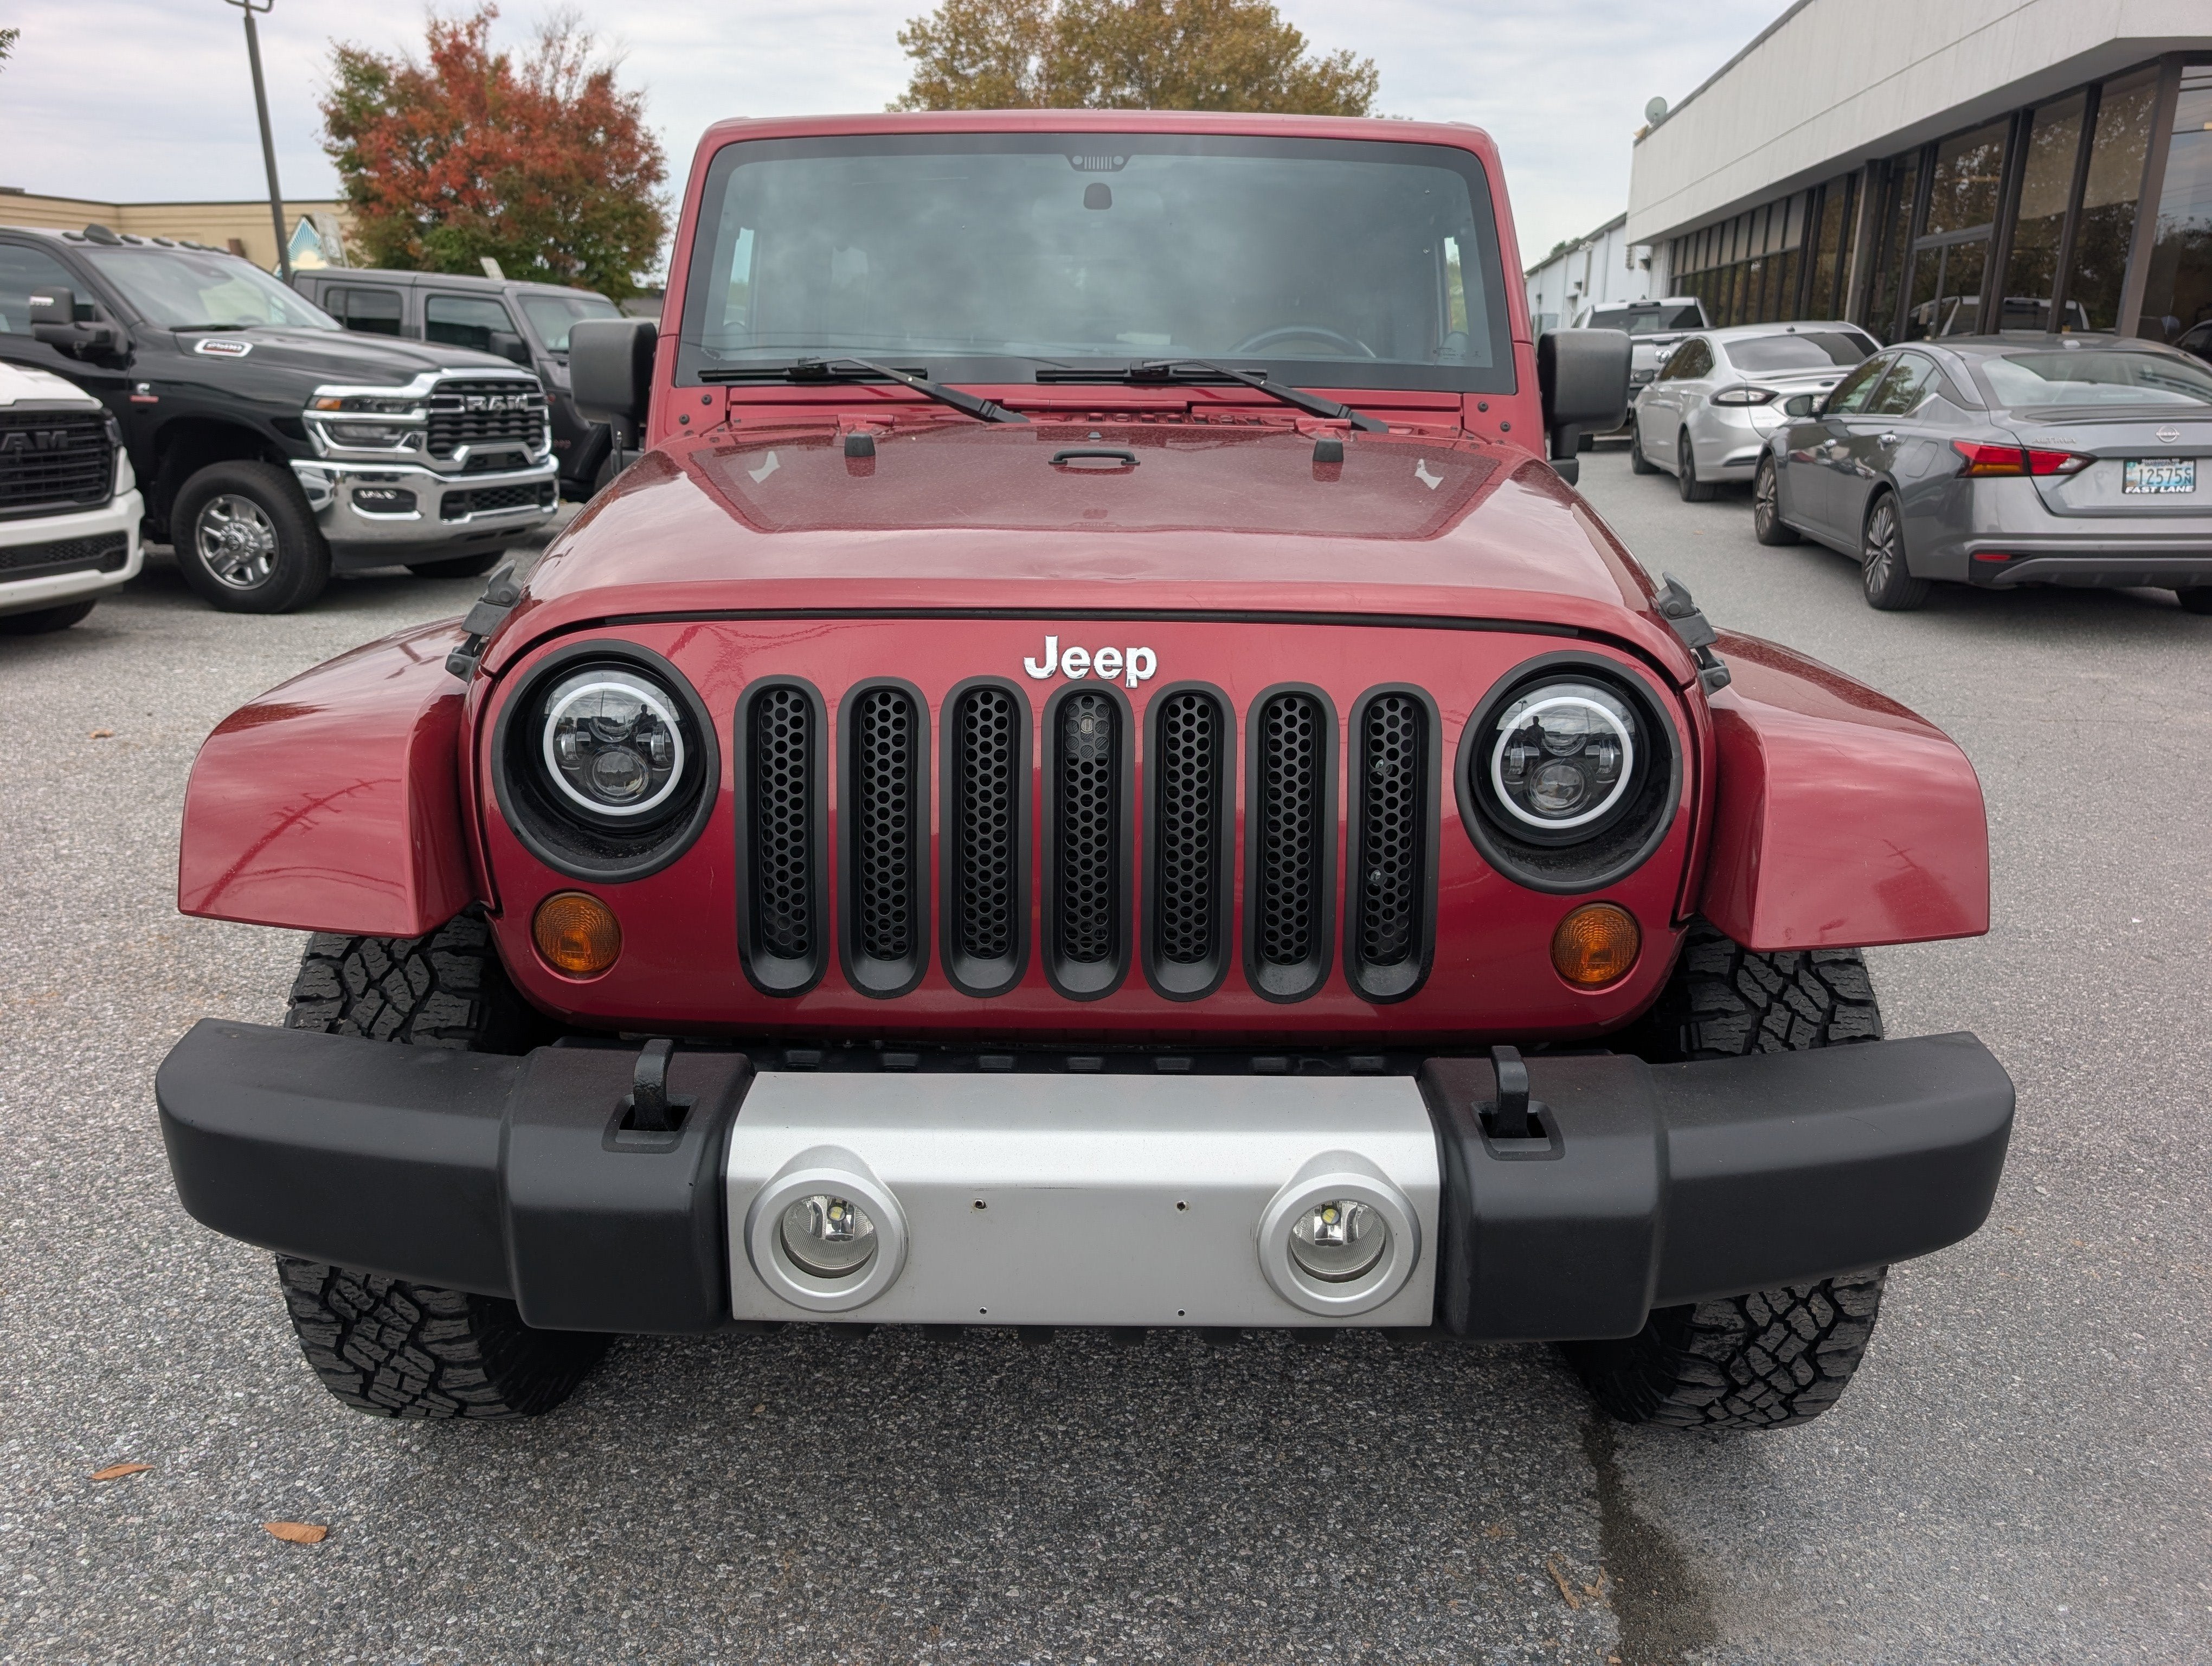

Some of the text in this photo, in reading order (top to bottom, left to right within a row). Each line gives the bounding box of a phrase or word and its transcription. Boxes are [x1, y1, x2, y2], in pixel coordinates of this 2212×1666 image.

[466, 395, 529, 411] RAM
[0, 430, 68, 451] AM
[2159, 485, 2195, 493] LANE
[1023, 635, 1158, 689] Jeep
